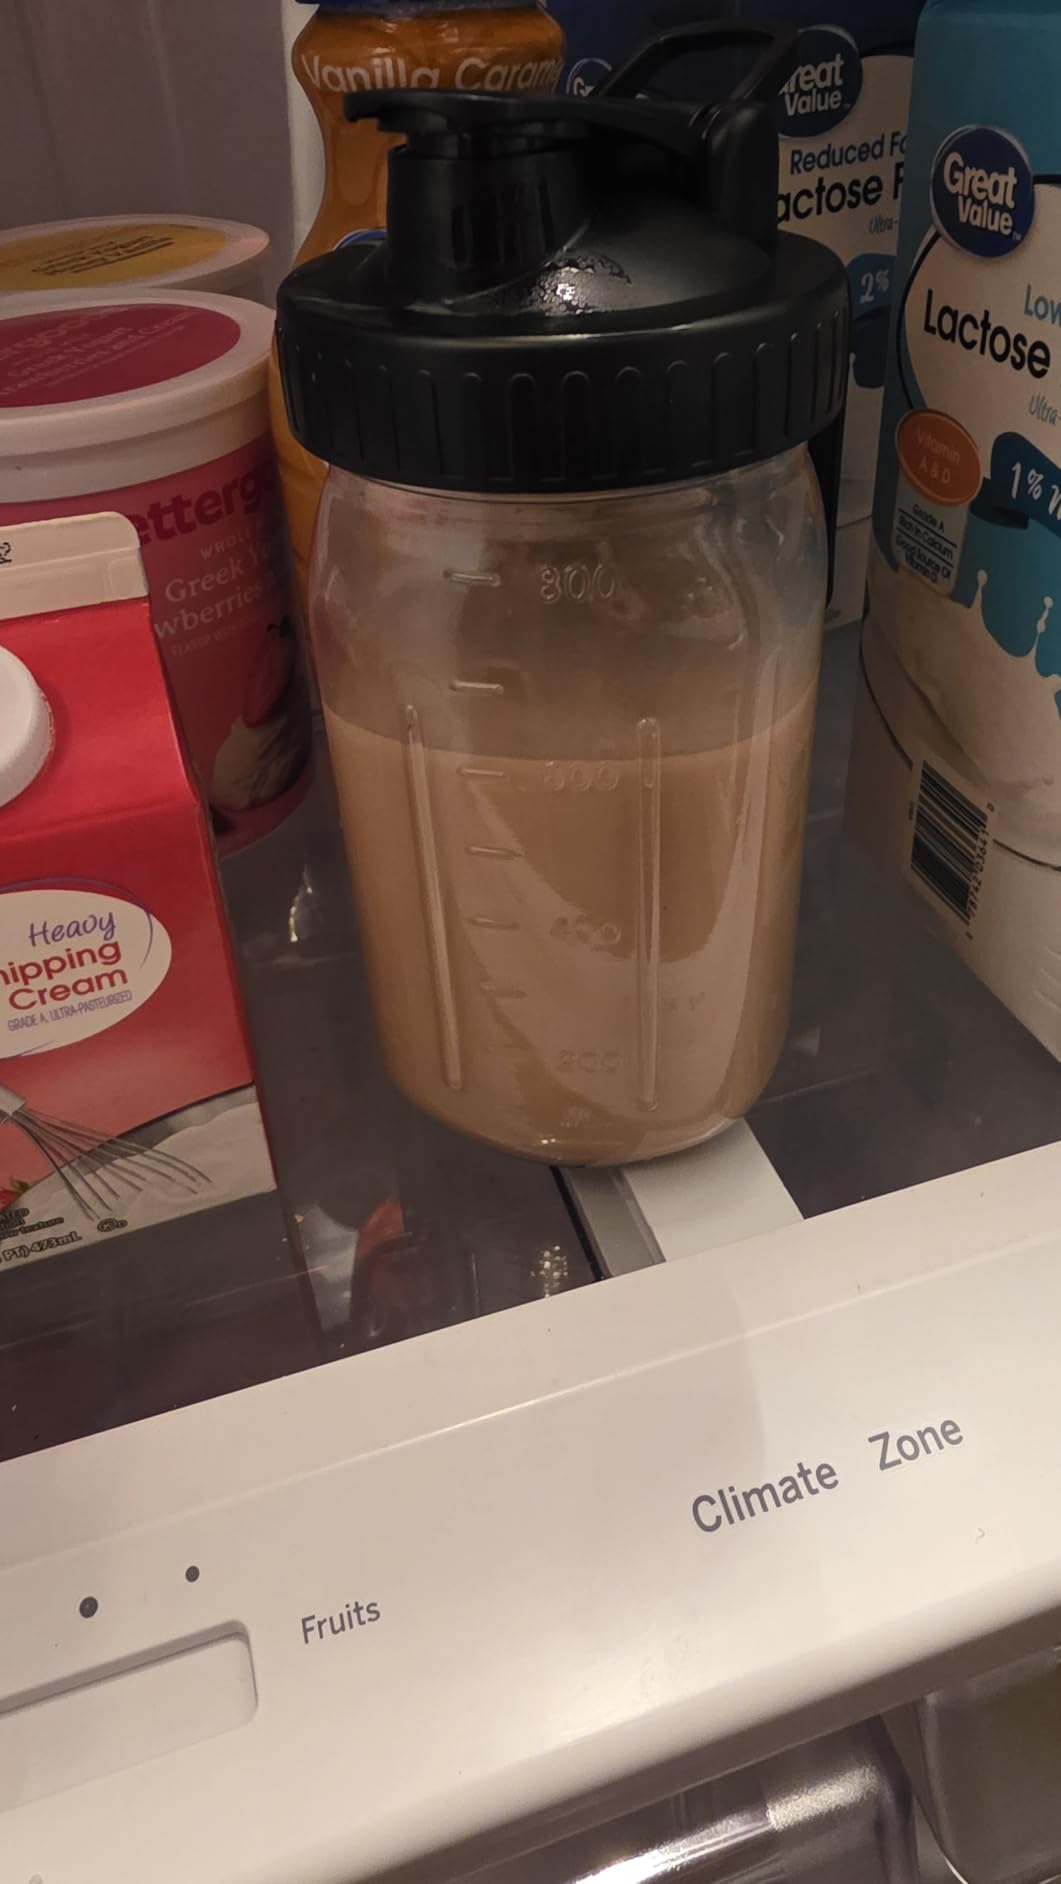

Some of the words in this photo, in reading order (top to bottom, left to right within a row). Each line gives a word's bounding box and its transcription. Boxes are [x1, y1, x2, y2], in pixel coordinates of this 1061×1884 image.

[301, 54, 441, 93] Vanilla
[780, 53, 844, 96] reat
[784, 89, 842, 117] Value
[790, 133, 885, 175] Reduced
[943, 151, 1018, 209] Great
[957, 195, 1014, 236] Value
[923, 288, 1052, 379] Lactose
[1010, 461, 1046, 501] 1%
[164, 557, 246, 603] Greek
[28, 911, 117, 947] Heavy
[9, 968, 129, 1010] Cream
[691, 1461, 840, 1533] Climate
[867, 1418, 964, 1472] Zone
[301, 1601, 381, 1645] Fruits
